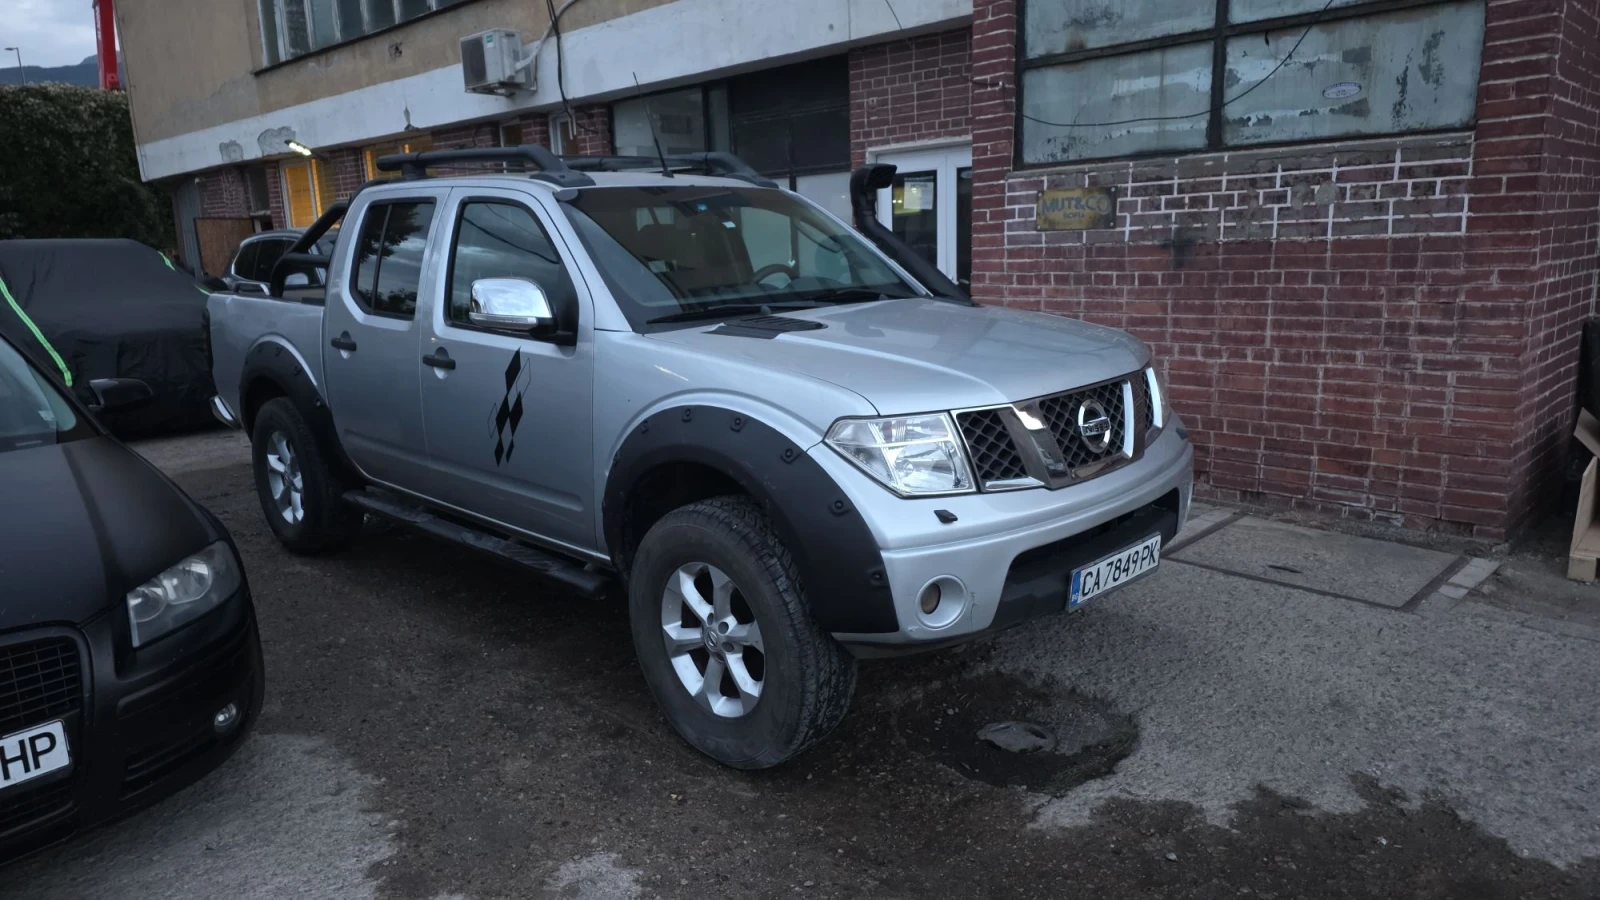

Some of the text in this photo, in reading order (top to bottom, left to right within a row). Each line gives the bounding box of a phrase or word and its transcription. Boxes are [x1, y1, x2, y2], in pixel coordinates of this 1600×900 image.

[1042, 194, 1112, 216] MUT&CO
[1082, 540, 1158, 597] CA 7849 PK
[0, 731, 57, 781] HP
